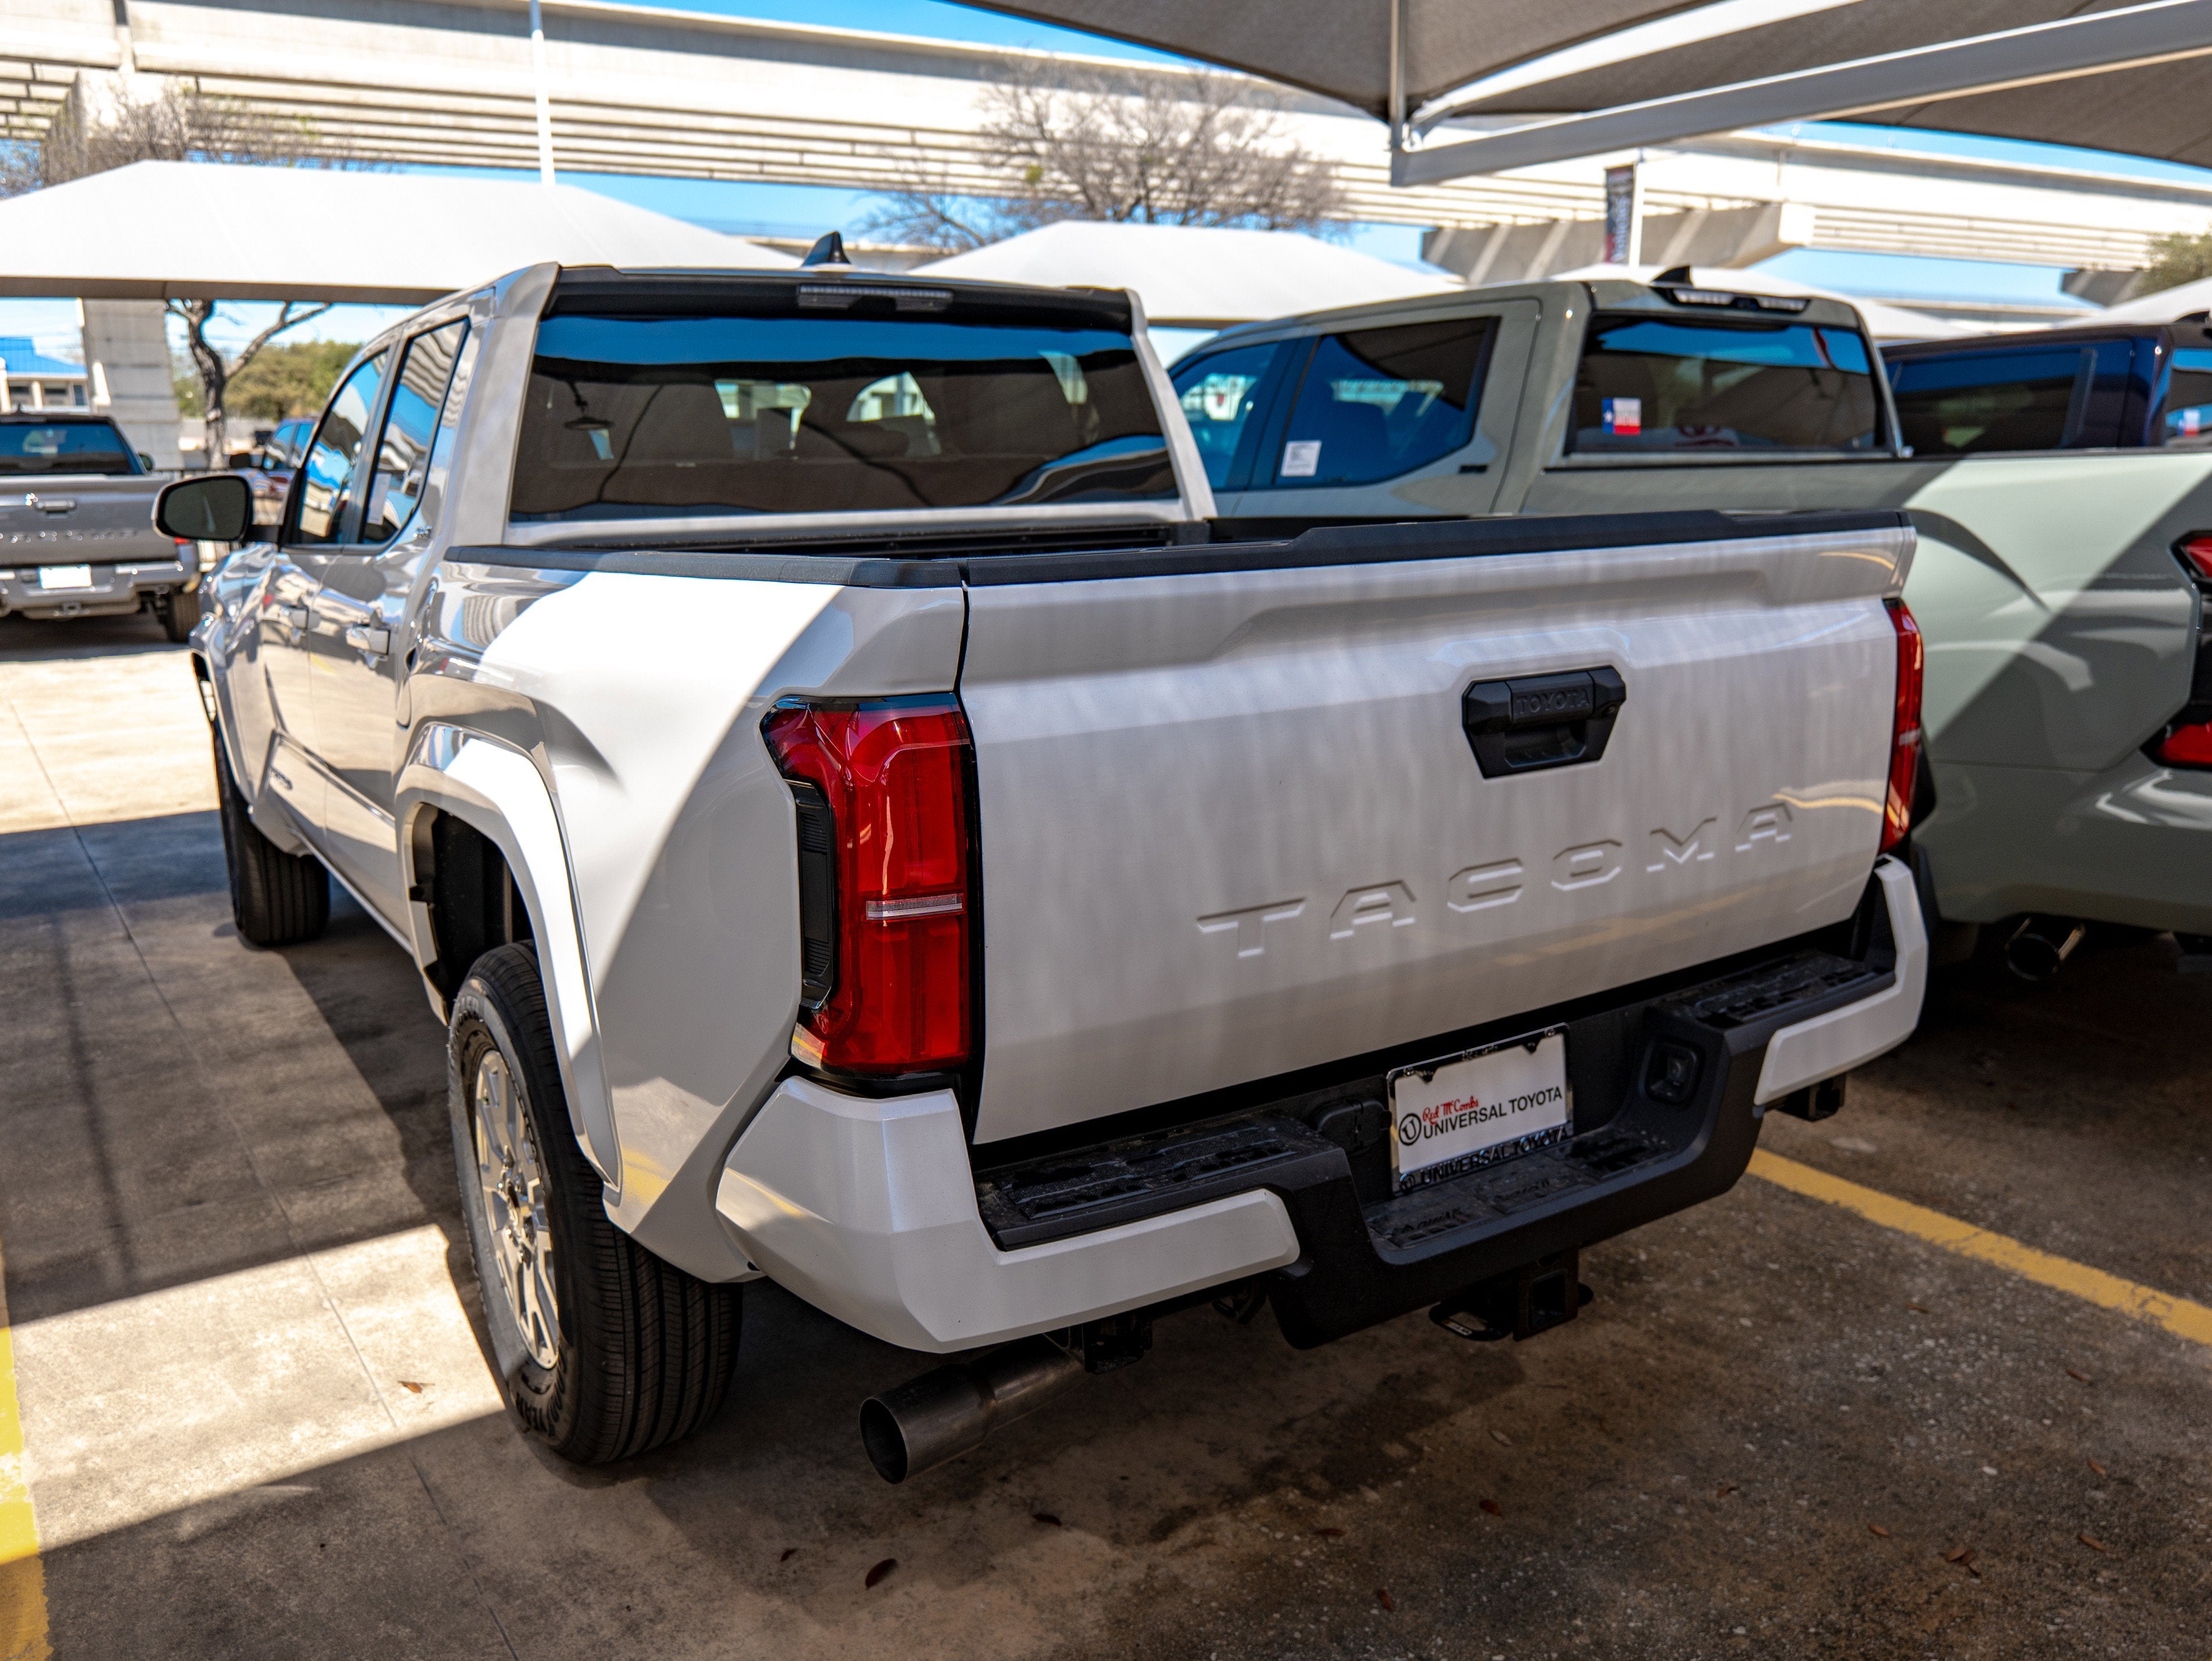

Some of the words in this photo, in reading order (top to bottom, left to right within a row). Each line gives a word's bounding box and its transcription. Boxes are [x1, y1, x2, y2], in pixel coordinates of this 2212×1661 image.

[1516, 688, 1591, 714] TOYOTA
[1196, 803, 1793, 958] TACOMA
[1423, 1103, 1507, 1139] UNIVERSAL
[1509, 1087, 1562, 1114] TOYOTA
[1423, 1106, 1439, 1125] Red
[1420, 1144, 1510, 1183] UNIVERSAL
[1510, 1126, 1567, 1158] TOYOTA
